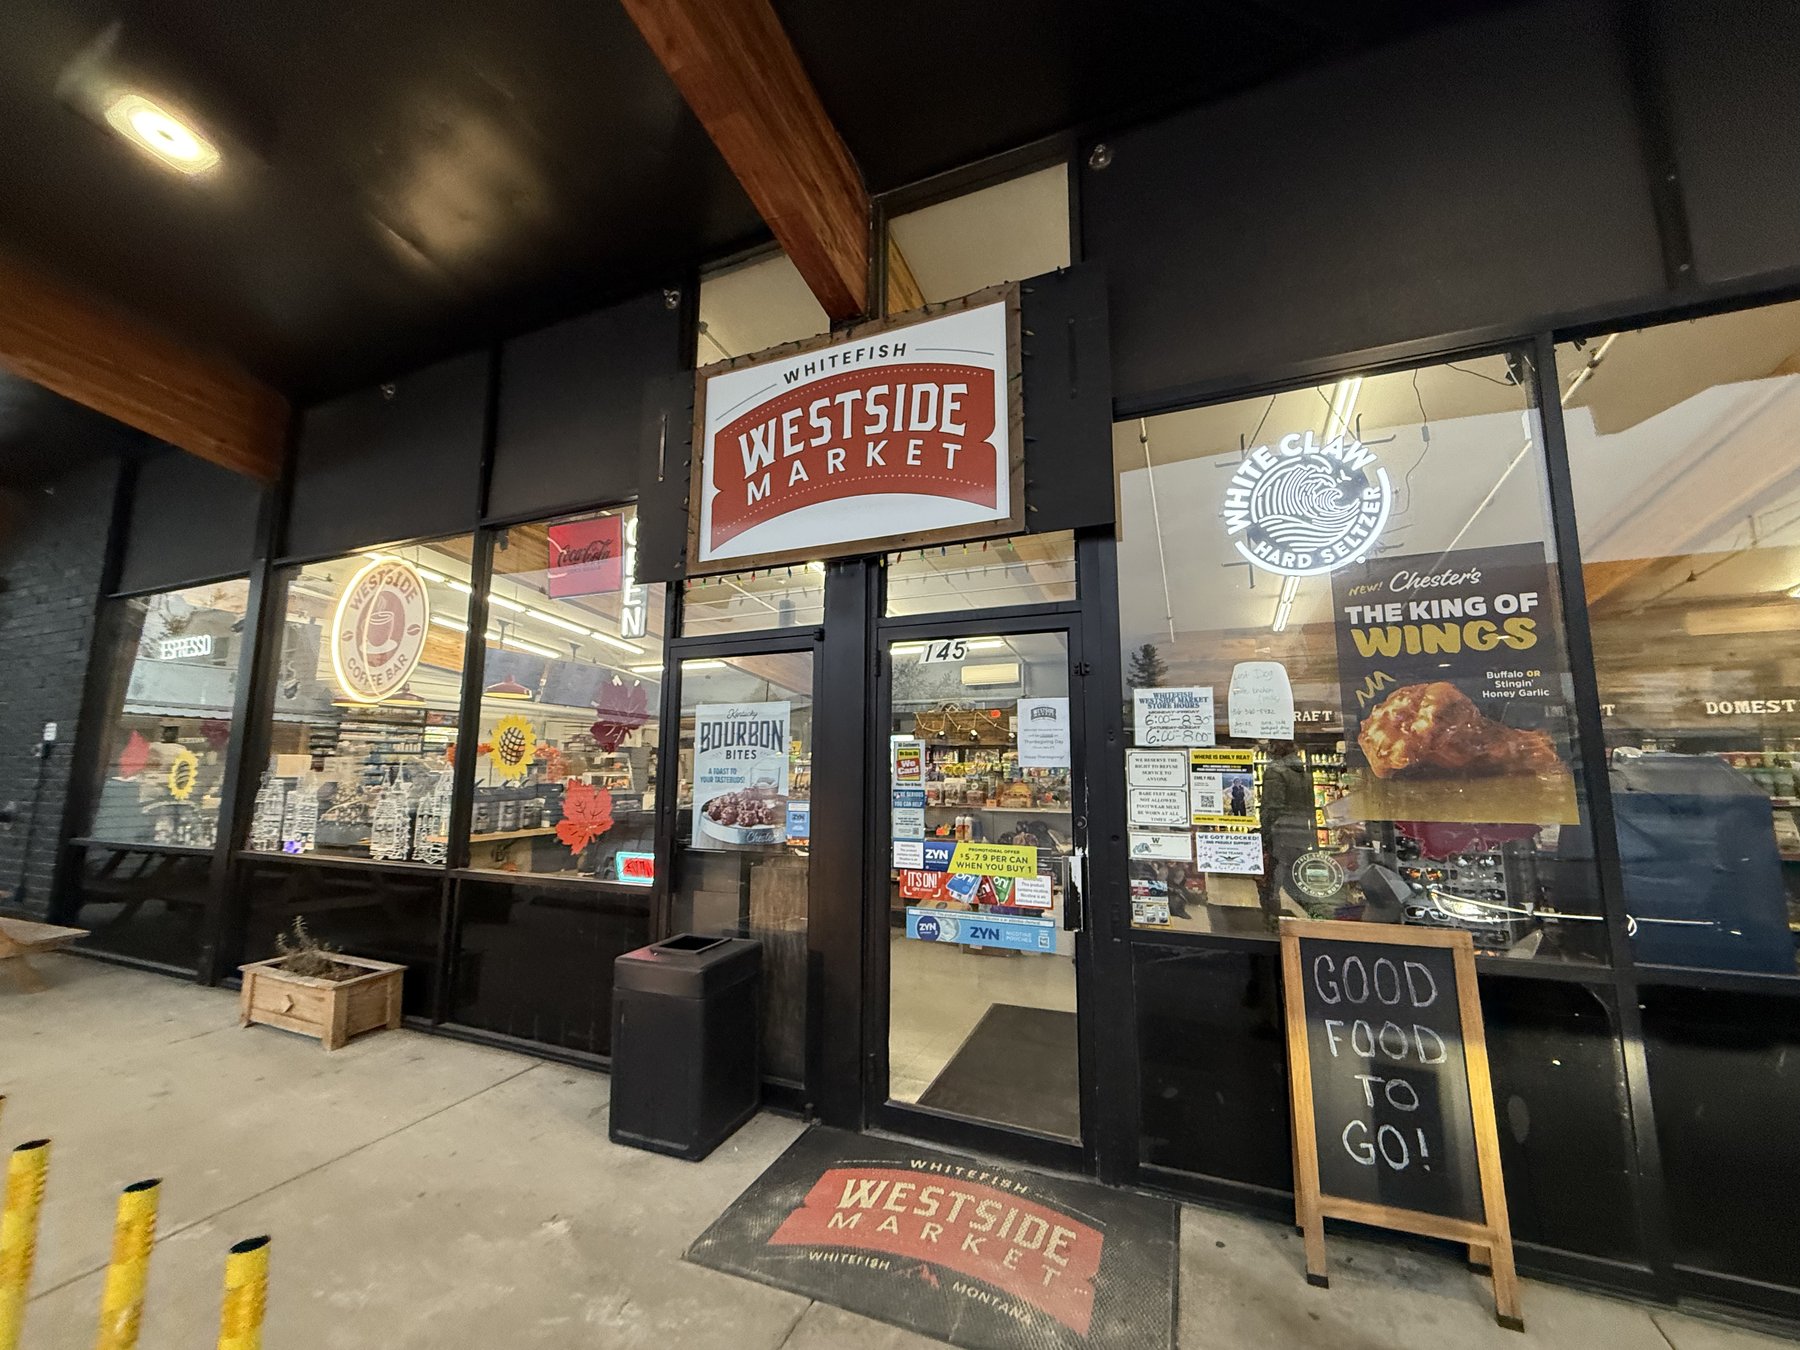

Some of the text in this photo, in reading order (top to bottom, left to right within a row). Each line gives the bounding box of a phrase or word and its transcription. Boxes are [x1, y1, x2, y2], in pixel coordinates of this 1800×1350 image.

[783, 342, 907, 385] WHITEFISH
[737, 382, 969, 480] WESTSIDE
[746, 439, 962, 506] MARKET
[1223, 430, 1378, 536] WHITE CLAW
[1253, 486, 1382, 568] HARD SELTZER
[349, 569, 418, 611] WESTSIDE
[1348, 567, 1482, 597] NEW! Chester's
[1344, 592, 1539, 625] THE KING OF
[925, 641, 967, 663] 145
[1350, 617, 1538, 658] WINGS
[347, 653, 409, 687] COFFEE BAR
[1486, 670, 1541, 679] Buffalo OR
[1482, 688, 1550, 699] Honey Garlic
[699, 719, 785, 754] BOURBON
[725, 749, 757, 760] BITES
[898, 766, 919, 775] Card
[901, 759, 916, 768] We
[925, 849, 948, 860] ZYN
[956, 861, 983, 870] WHEN
[985, 863, 1004, 872] YOU
[1006, 865, 1025, 873] BUY
[990, 855, 1007, 864] PER
[1009, 856, 1029, 864] CAN
[919, 922, 937, 931] ZYN
[970, 926, 1000, 941] ZYN
[1313, 954, 1438, 1007] GOOD
[1324, 1019, 1448, 1064] FOOD
[1354, 1074, 1420, 1111] TO
[1341, 1119, 1431, 1172] GO!
[910, 1158, 1029, 1194] WHITEFISH
[835, 1178, 1077, 1268] WESTSIDE
[827, 1212, 1062, 1287] MARKET
[808, 1251, 1032, 1326] WHITEFISH MONTANA
